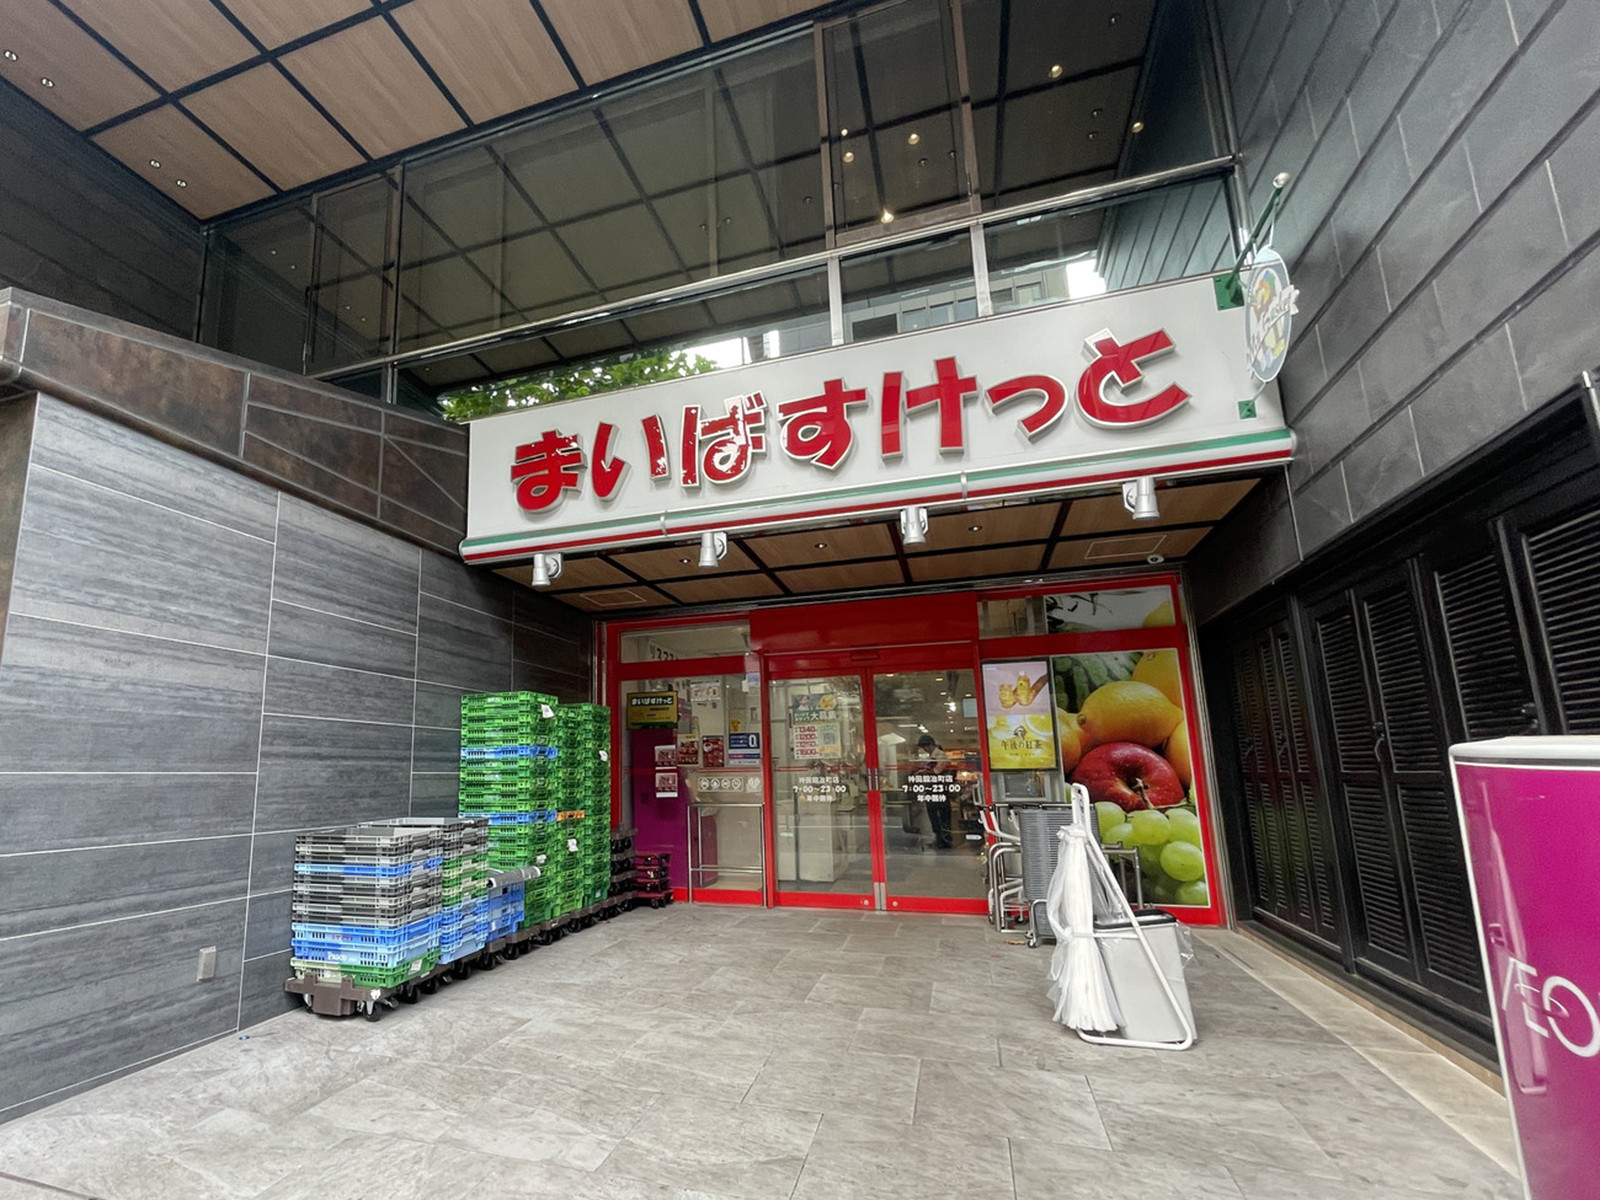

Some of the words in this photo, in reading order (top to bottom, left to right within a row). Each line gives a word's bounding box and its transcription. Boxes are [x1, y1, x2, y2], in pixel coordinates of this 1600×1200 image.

[510, 328, 1190, 513] まいばすけっと
[1502, 957, 1600, 1058] AEO
